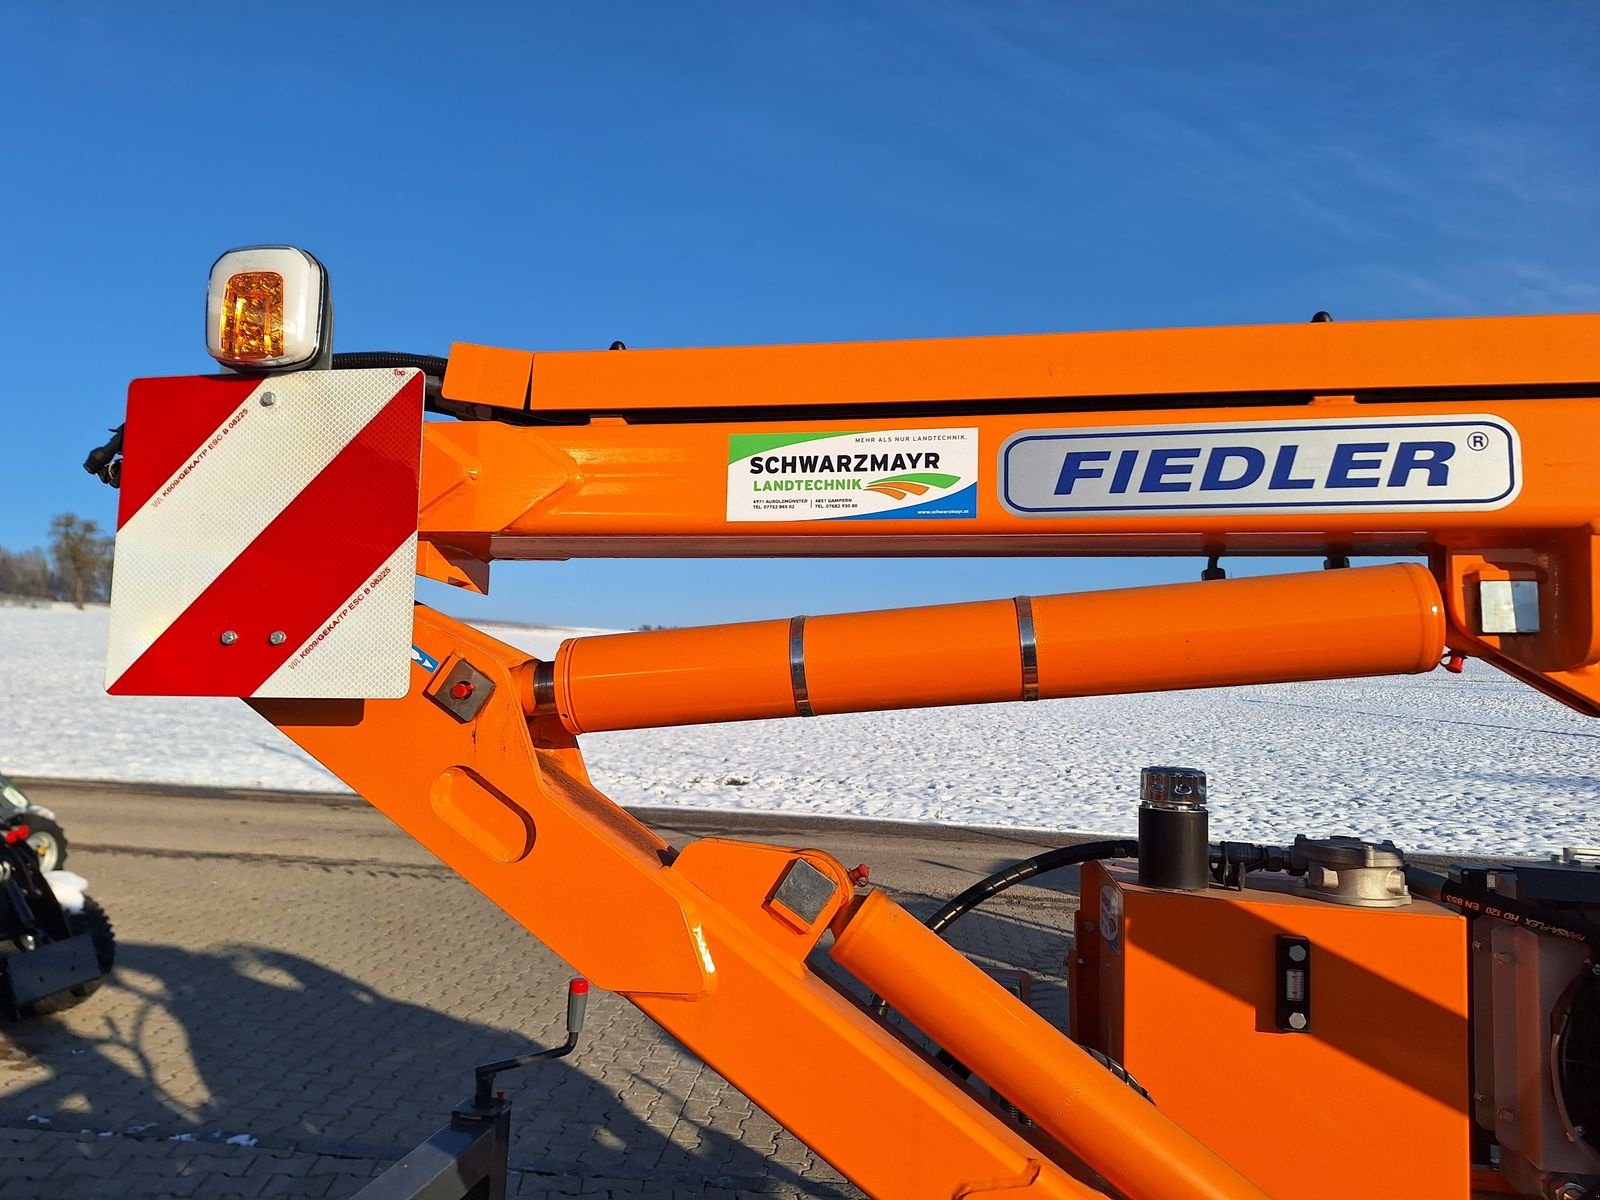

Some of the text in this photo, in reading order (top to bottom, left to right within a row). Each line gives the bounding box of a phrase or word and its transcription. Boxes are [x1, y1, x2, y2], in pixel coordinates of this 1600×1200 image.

[207, 433, 223, 450] ESC
[228, 407, 249, 429] 08225
[912, 434, 968, 442] LANDTECHNIK.
[750, 452, 940, 474] SCHWARZMAYR
[1053, 441, 1457, 496] FIEDLER
[753, 478, 862, 492] LANDTECHNIK
[299, 566, 391, 659] K609/GEKA/TP ESC B 08225
[1446, 894, 1587, 942] HANSA-FLEX HD 120 EN 853
